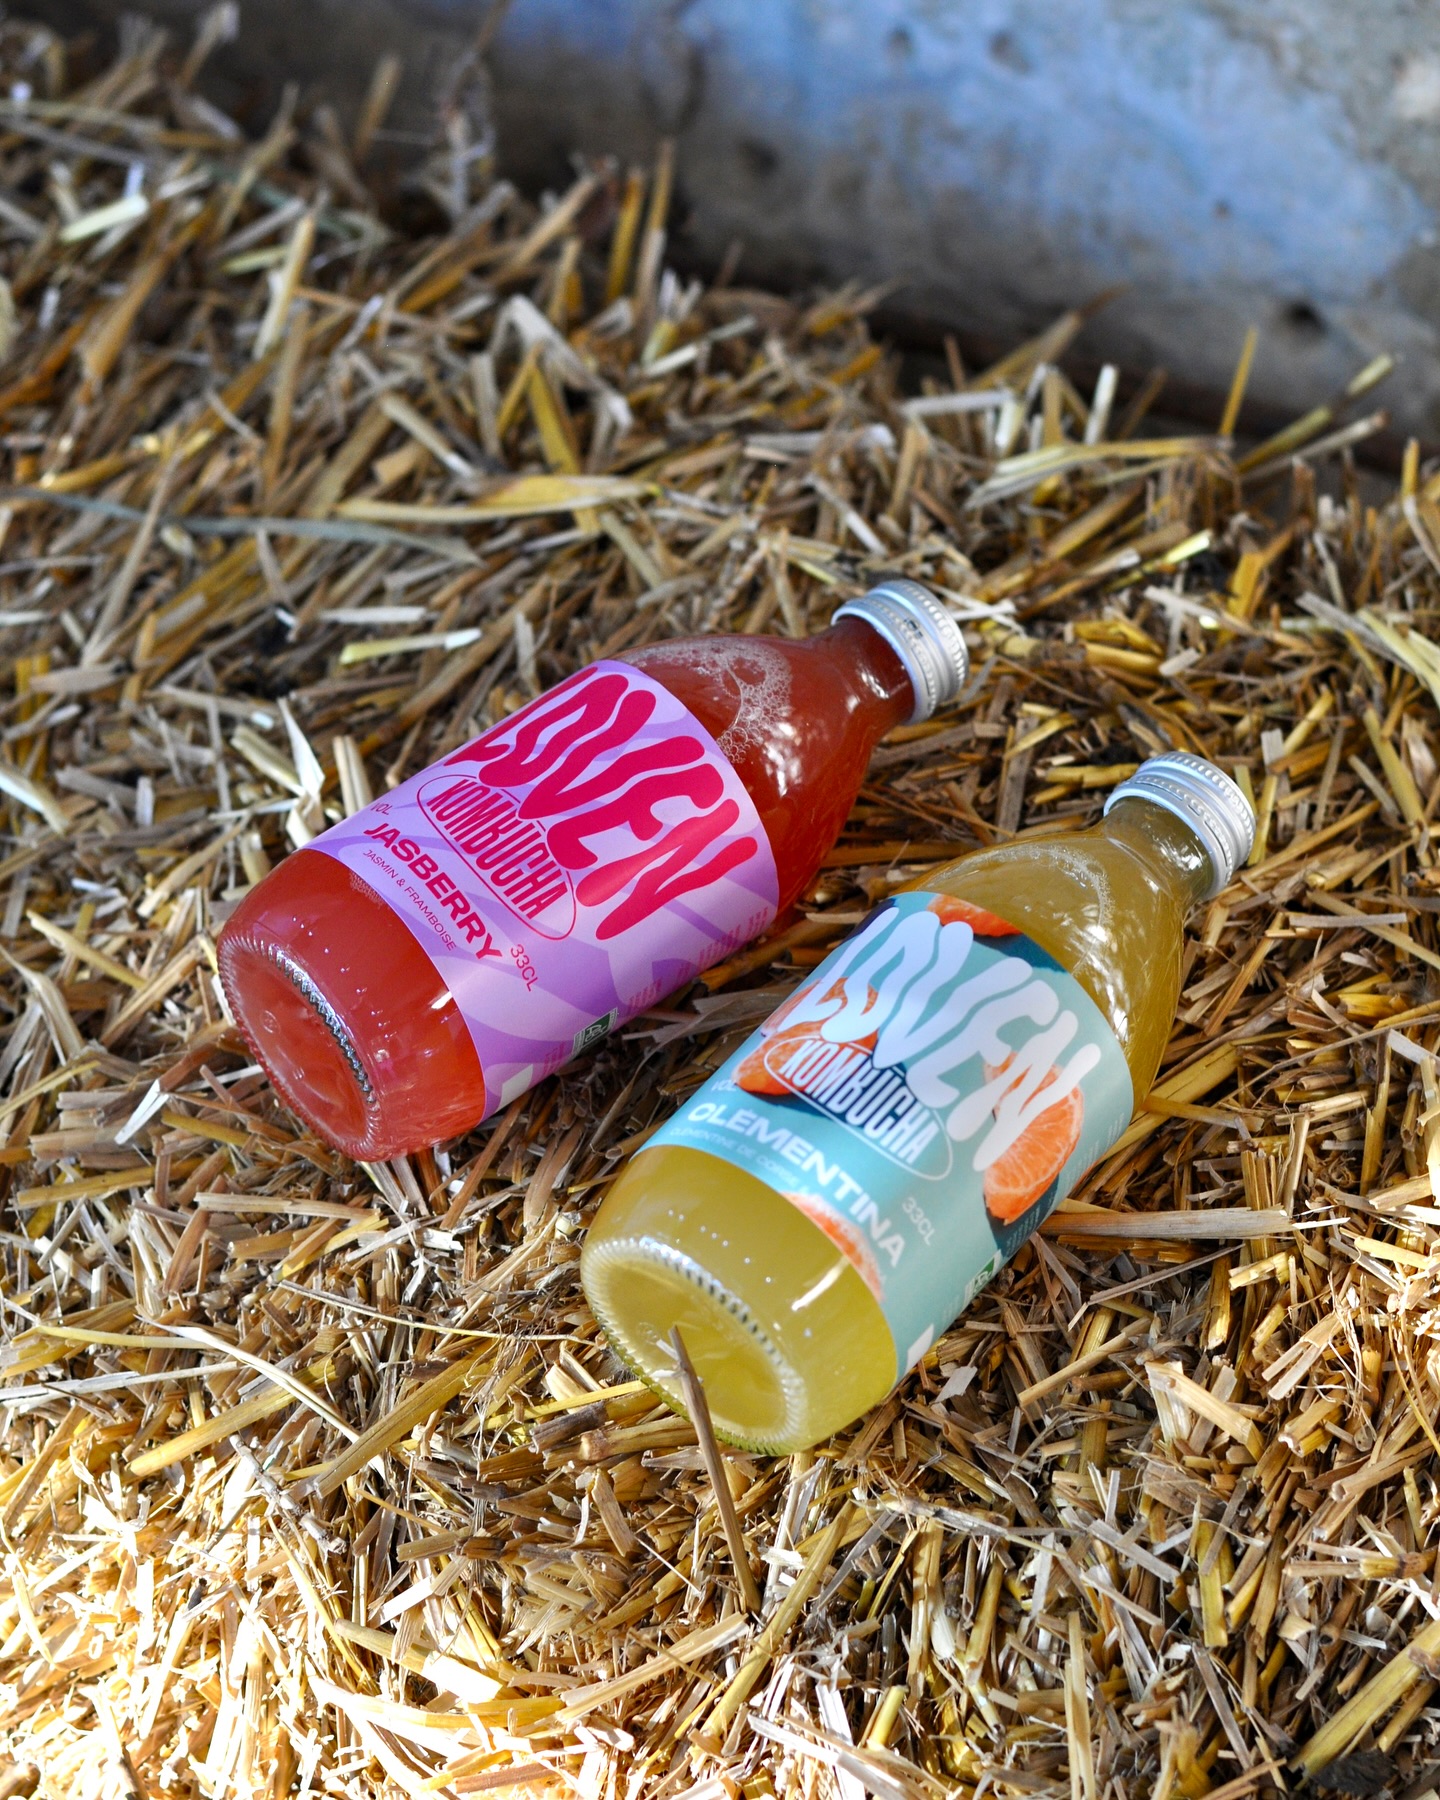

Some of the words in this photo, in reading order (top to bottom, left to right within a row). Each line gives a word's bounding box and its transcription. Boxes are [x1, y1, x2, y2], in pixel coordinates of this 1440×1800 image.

[443, 666, 759, 941] LOVEN
[363, 823, 502, 959] JASBERRY
[363, 850, 397, 879] JASMIN
[396, 878, 405, 887] &
[404, 886, 457, 951] FRAMBOISE
[510, 944, 538, 992] 33CL
[778, 907, 1101, 1172] LOVEN
[902, 1196, 935, 1246] 33CL
